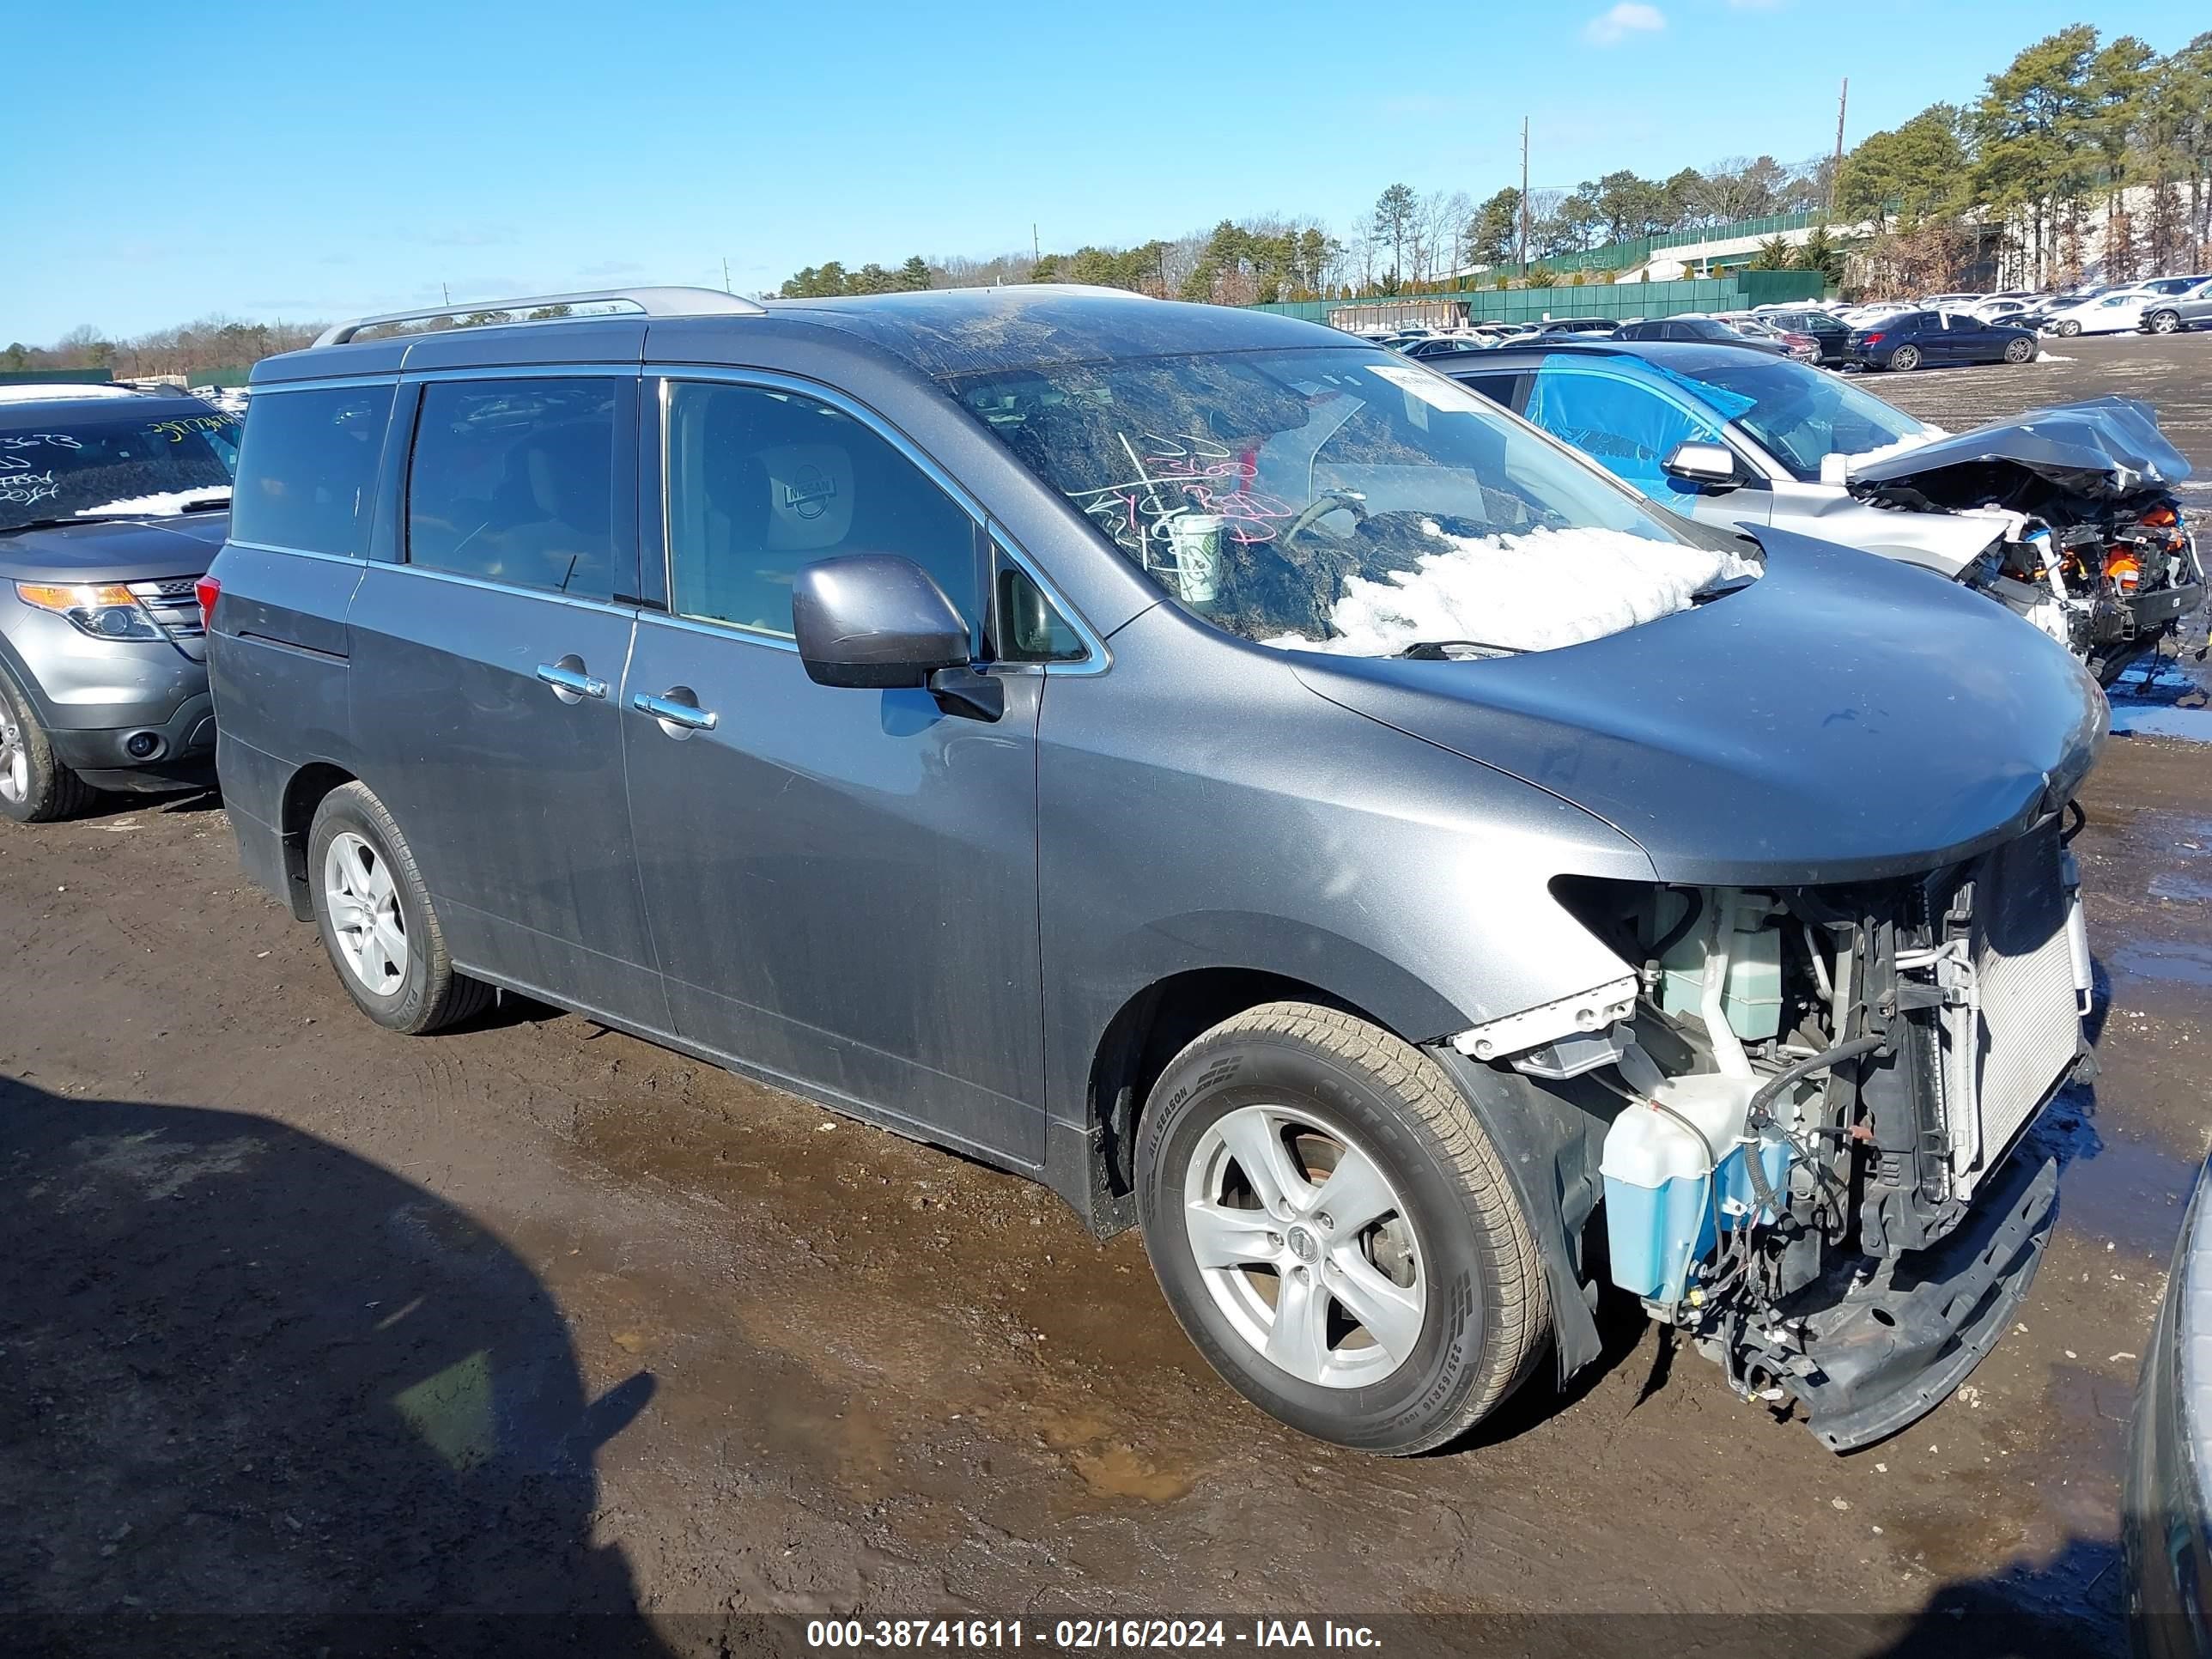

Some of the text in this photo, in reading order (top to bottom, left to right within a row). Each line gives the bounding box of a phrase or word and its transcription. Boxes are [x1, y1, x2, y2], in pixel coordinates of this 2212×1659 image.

[789, 479, 832, 501] NISSAN
[1148, 1085, 1188, 1160] ALL SEASON
[1422, 1343, 1463, 1413] 225/65R16
